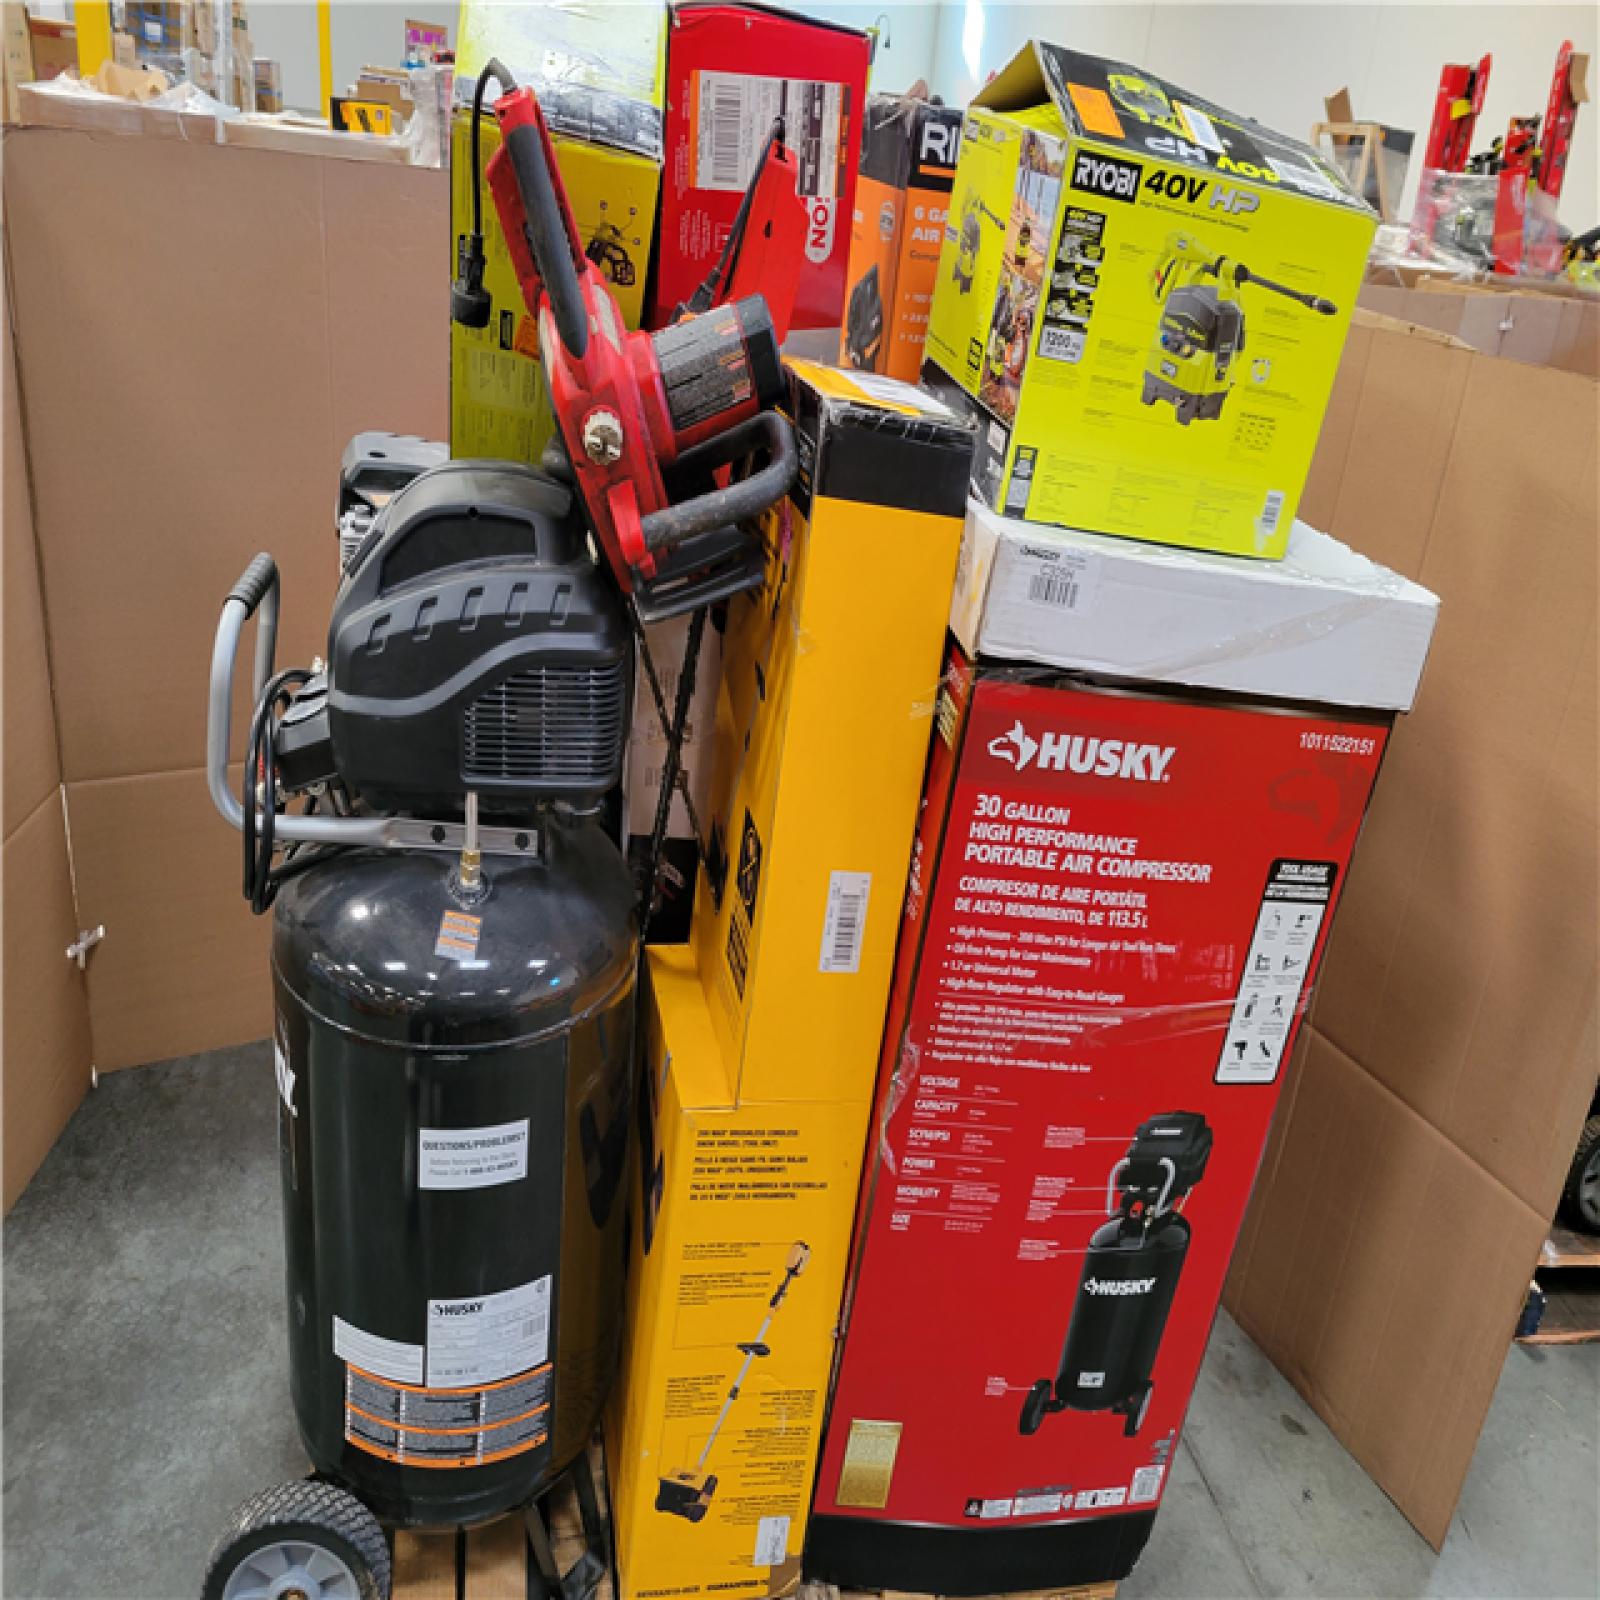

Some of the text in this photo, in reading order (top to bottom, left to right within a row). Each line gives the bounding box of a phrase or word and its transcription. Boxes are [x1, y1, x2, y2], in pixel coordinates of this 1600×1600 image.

[1073, 155, 1262, 216] RYOBI 40V HP
[911, 227, 942, 243] AIR
[1037, 732, 1177, 783] HUSKY
[974, 793, 1071, 826] 30 GALLON
[969, 821, 1139, 856] HIGH PERFORMANCE
[964, 842, 1214, 884] PORTABLE AIR COMPRESSOR
[959, 876, 1039, 900] COMPRESOR
[1041, 883, 1061, 901] DE
[1062, 885, 1091, 904] AIRE
[954, 897, 972, 913] DE
[972, 899, 1002, 917] ALTO
[1087, 910, 1106, 926] DE
[1097, 1277, 1157, 1296] HUSKY
[444, 1301, 484, 1316] HUSKY
